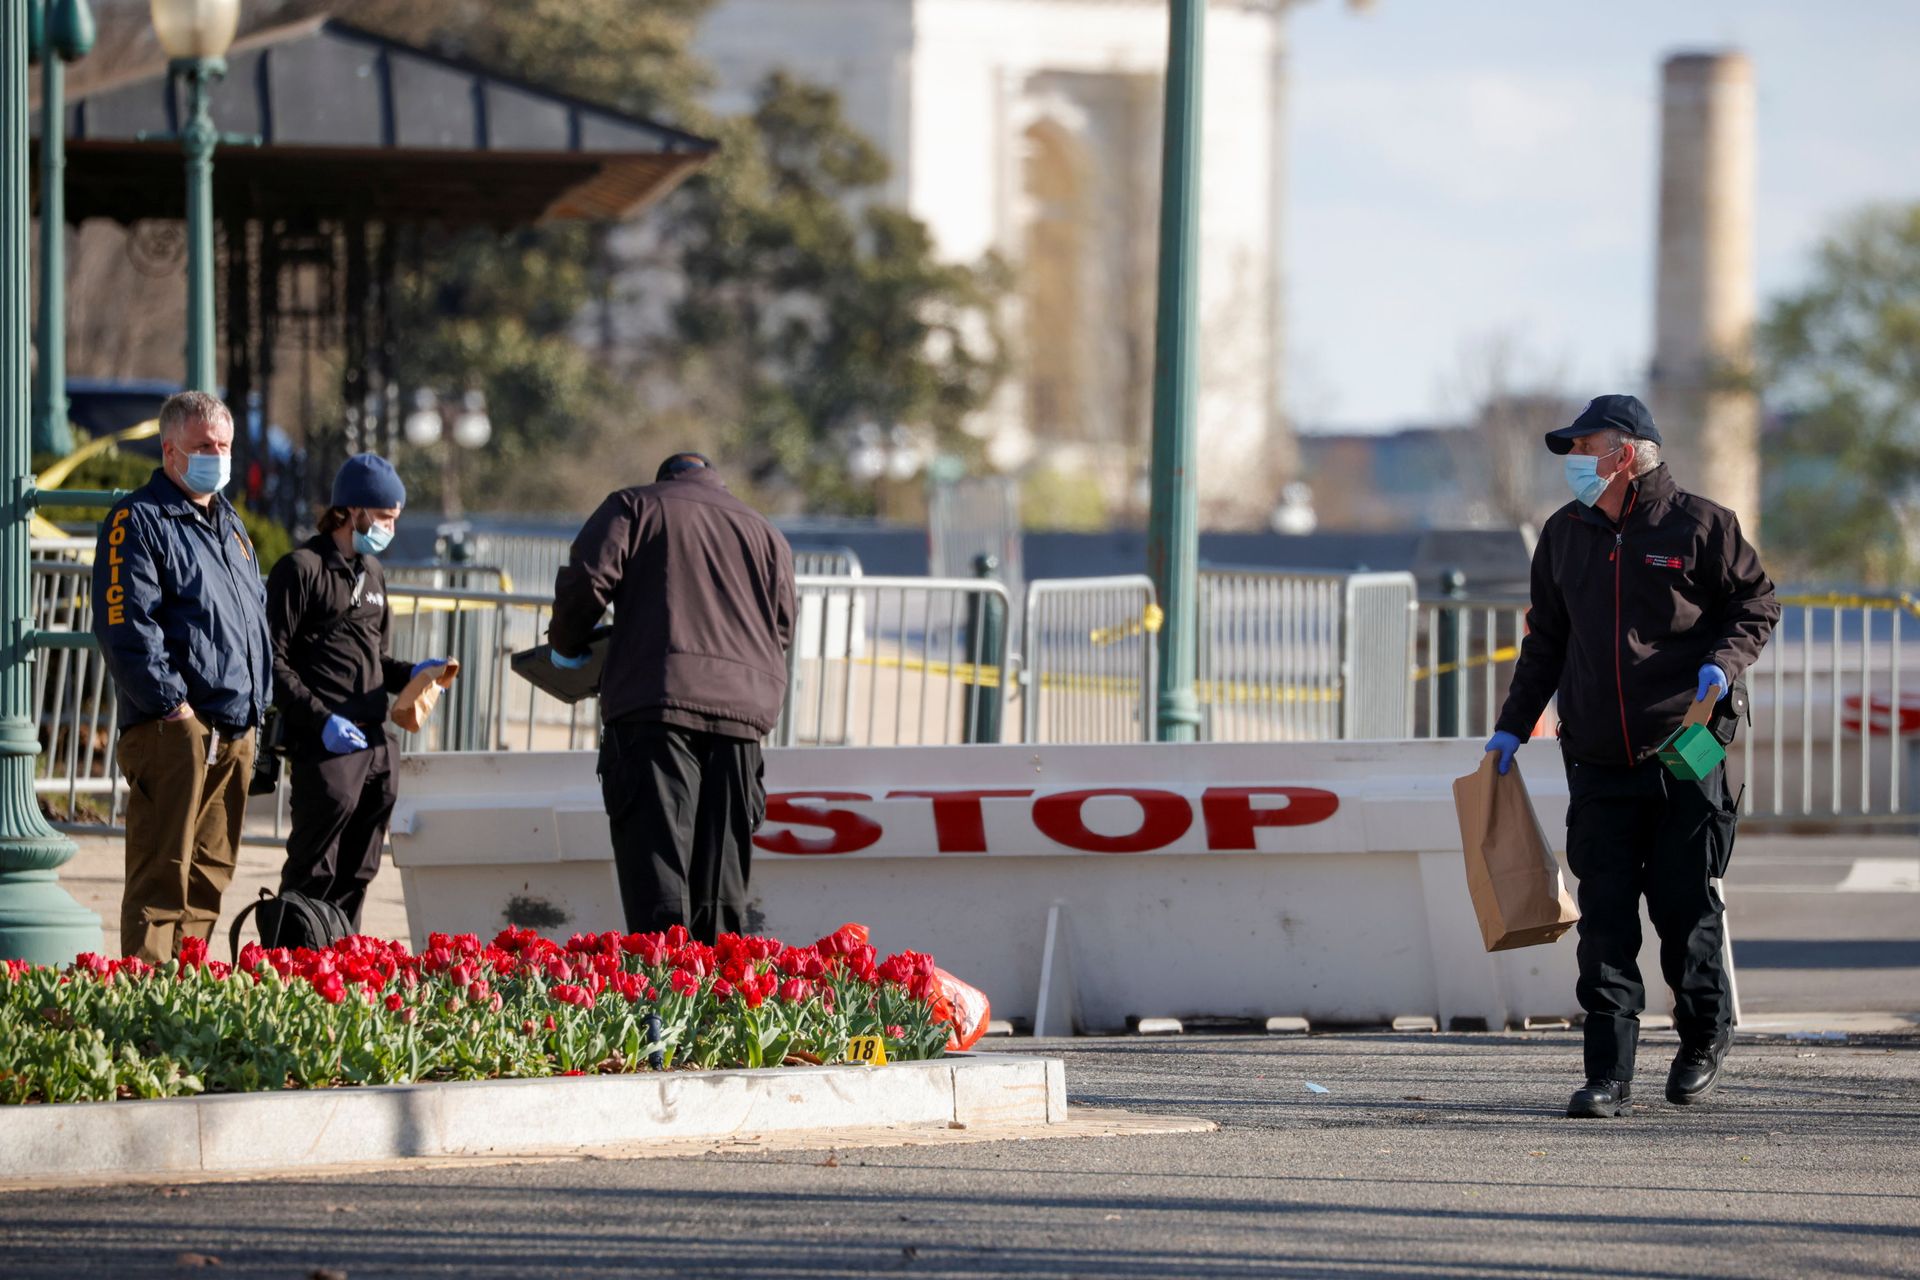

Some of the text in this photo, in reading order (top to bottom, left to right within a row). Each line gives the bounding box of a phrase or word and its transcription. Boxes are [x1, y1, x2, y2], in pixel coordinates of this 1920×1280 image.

[106, 508, 129, 625] POLICE
[751, 787, 1339, 854] STOP
[853, 1040, 875, 1060] 18
